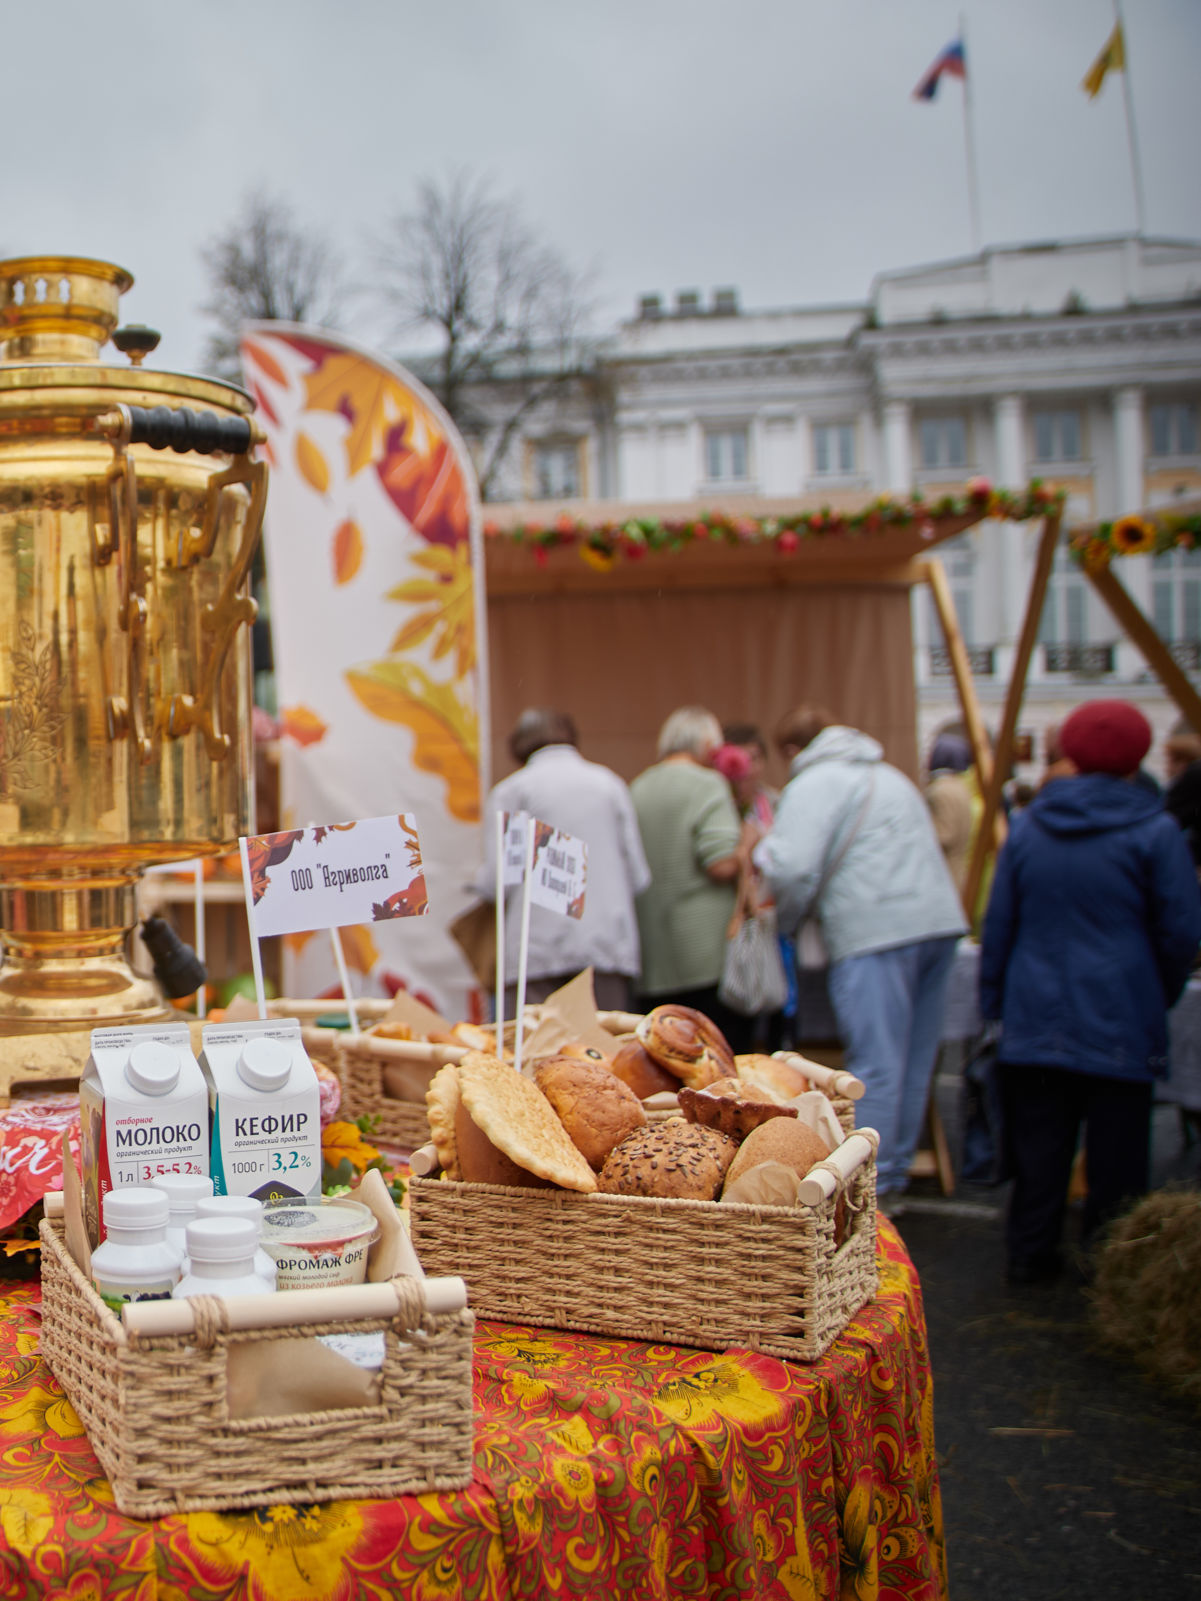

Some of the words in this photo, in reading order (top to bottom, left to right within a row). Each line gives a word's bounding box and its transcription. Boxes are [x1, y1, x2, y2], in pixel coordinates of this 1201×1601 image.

[291, 868, 313, 892] ООО
[116, 1117, 153, 1126] отборное
[235, 1113, 308, 1137] КЕФИР
[116, 1123, 201, 1147] МОЛОКО
[234, 1136, 279, 1147] органический
[280, 1135, 308, 1144] продукт
[116, 1147, 163, 1158] органический
[164, 1145, 193, 1154] продукт
[143, 1161, 202, 1180] 3,5-52%
[232, 1161, 257, 1174] 1000
[259, 1163, 265, 1172] г
[272, 1151, 312, 1174] 3,2%
[118, 1171, 123, 1183] 1
[126, 1173, 134, 1182] л
[276, 1254, 342, 1271] ФРОМАЖ
[344, 1249, 363, 1264] ФРЕ
[280, 1282, 289, 1290] из
[291, 1281, 325, 1290] козьего
